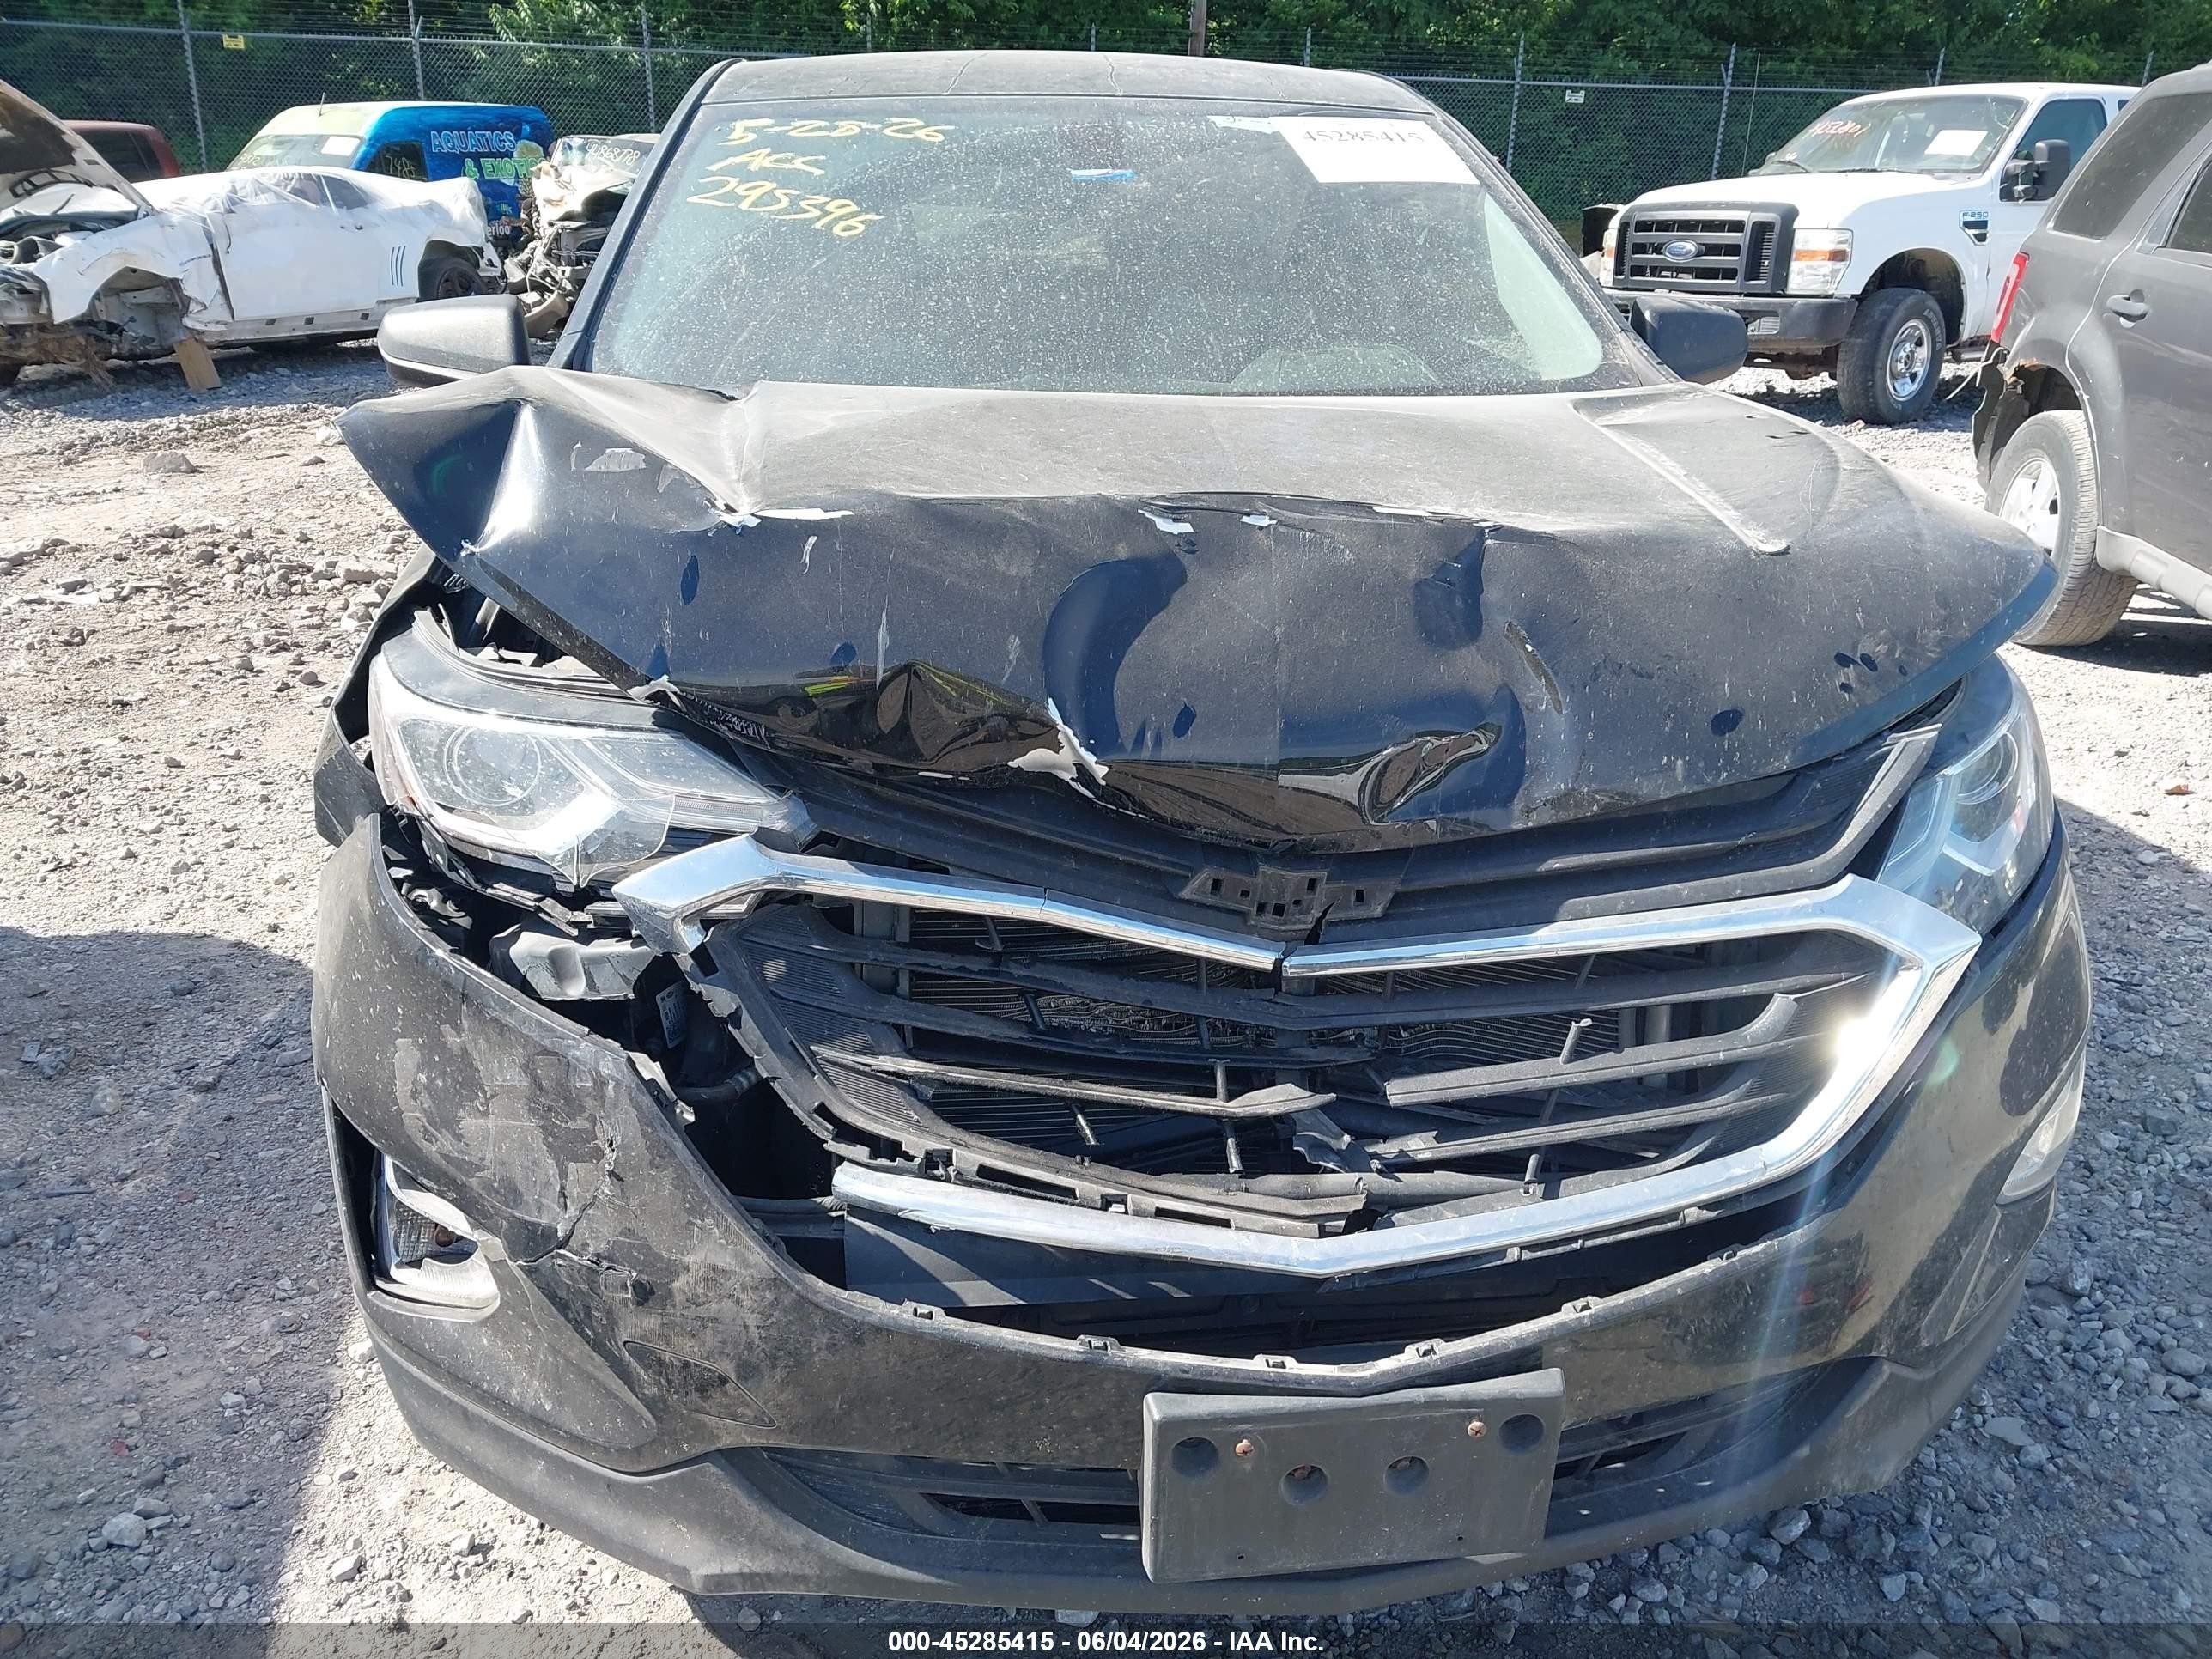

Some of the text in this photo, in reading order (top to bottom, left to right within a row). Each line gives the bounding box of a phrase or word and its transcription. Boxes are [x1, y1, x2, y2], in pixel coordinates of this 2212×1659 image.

[431, 131, 517, 154] AQUATICS
[464, 158, 480, 180] &
[686, 175, 884, 237] 295396
